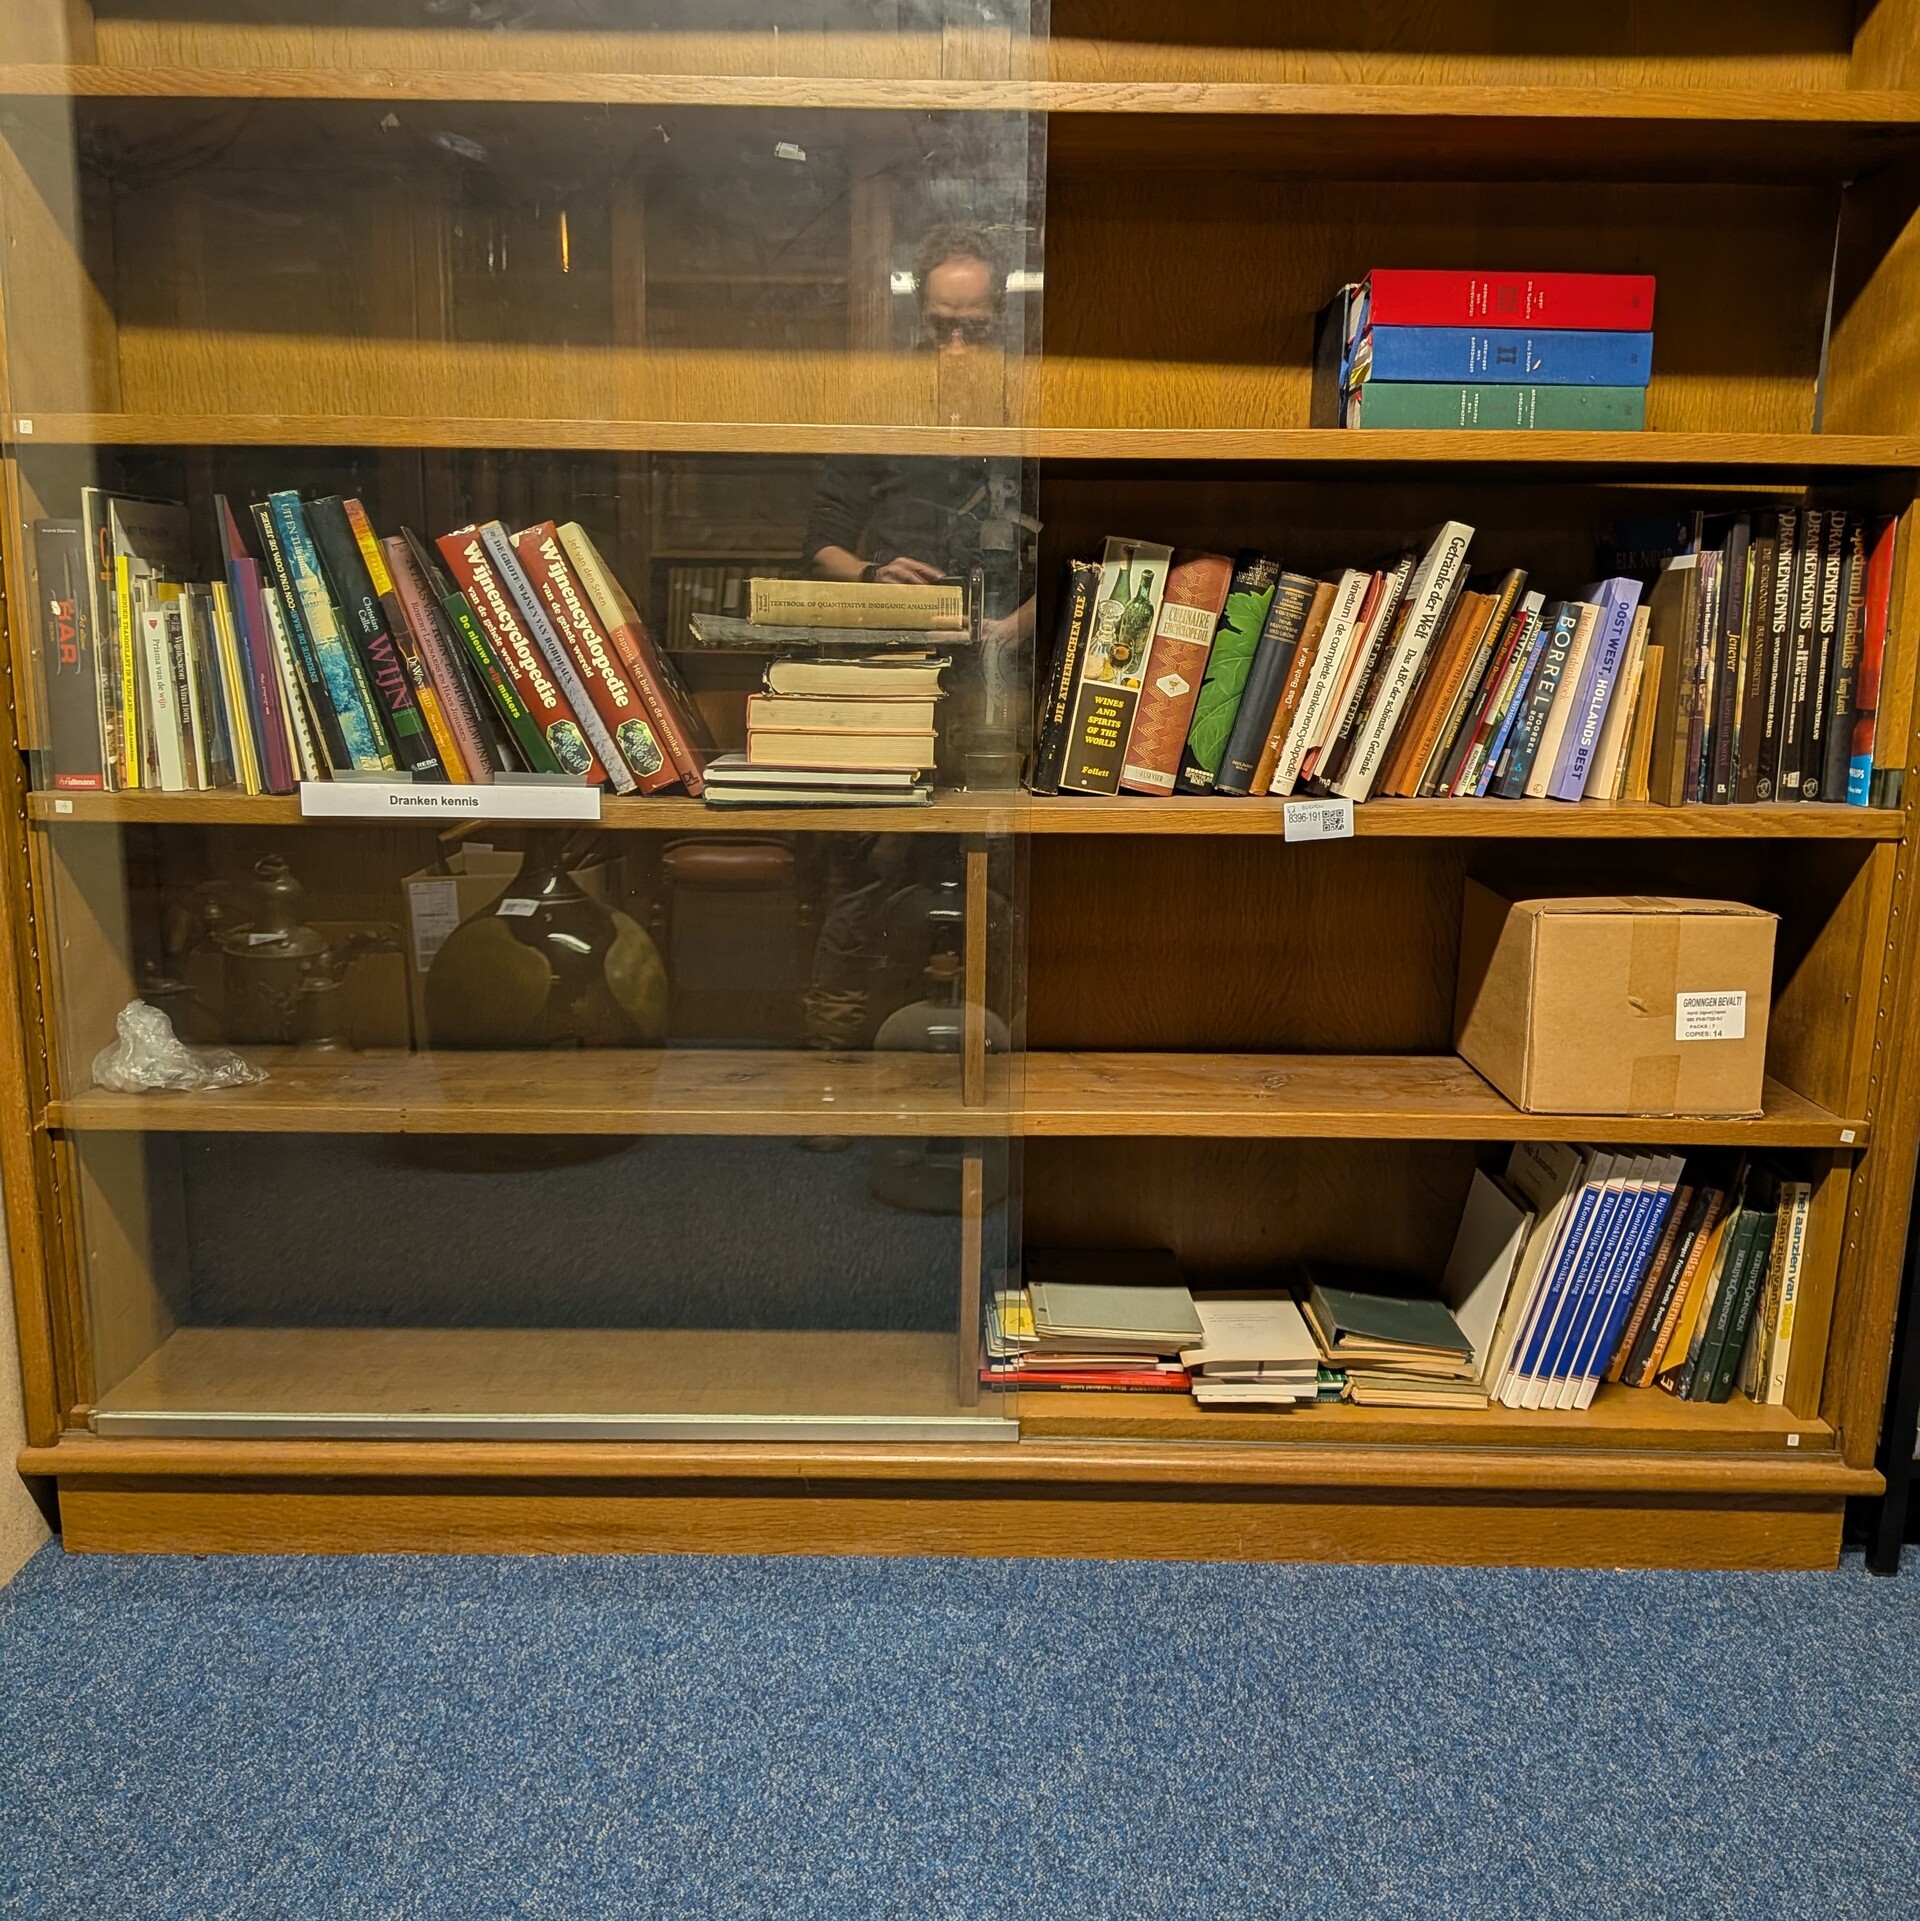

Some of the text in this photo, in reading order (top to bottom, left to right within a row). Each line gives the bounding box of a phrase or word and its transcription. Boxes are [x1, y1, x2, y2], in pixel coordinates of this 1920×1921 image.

[259, 511, 295, 609] CON UNA COPA DE JEREZ
[404, 557, 430, 602] ATLAS
[566, 536, 606, 606] Jef van den Steen
[1413, 536, 1465, 639] Getränke der Welt
[1772, 515, 1795, 632] DRANKENKENNIS
[1799, 510, 1821, 628] DRANKENKENNIS
[1820, 516, 1845, 633] DRANKENKENNIS
[357, 608, 371, 632] Callec
[362, 596, 378, 631] Christian
[423, 601, 439, 628] VAN
[465, 541, 555, 707] Wijnencyclopedie
[492, 539, 573, 684] DE GROTE WIJNEN VAN BORDEAUX
[540, 538, 627, 706] Wijnencyclopedie
[768, 599, 805, 607] TEXTBOOK
[807, 600, 816, 608] OF
[817, 600, 867, 610] QUANTITATIVE
[1168, 611, 1211, 629] CULINAIRE
[1494, 611, 1505, 622] EN
[1498, 578, 1518, 612] KLASSIEKE
[1750, 547, 1772, 697] DE GEKROONDE BRANDERSKETEL
[458, 614, 470, 629] De
[467, 630, 490, 664] nieuwe
[467, 585, 522, 680] van de gehele wereld
[542, 581, 594, 678] van de gehele wereld
[1162, 622, 1209, 642] ENCYCLOPEDIE
[1339, 560, 1411, 738] INTERNATIONALE DRANKRECEPTEN
[1484, 620, 1501, 646] TRENDY
[1508, 605, 1536, 665] JENEVER
[1559, 611, 1592, 702] Het literair drinkboek
[1726, 629, 1740, 672] Jenever
[1841, 595, 1862, 668] Drankatlas
[152, 638, 167, 709] Prisma van de wijn
[368, 633, 412, 708] WIJN
[410, 601, 427, 631] ROBERT
[422, 632, 442, 672] LEENAERS
[437, 672, 445, 683] EN
[441, 684, 454, 706] HANS
[450, 707, 467, 741] JORISSEN
[443, 661, 458, 682] EN
[1284, 580, 1361, 776] vinetum de complete drankenencyclopedie
[1461, 645, 1491, 698] COCKTAILS
[1533, 615, 1575, 704] BORREL
[1794, 649, 1808, 701] HOTELSCHOOL
[615, 628, 681, 756] Trappist. Het bier en de monniken
[1094, 695, 1125, 709] WINES
[1095, 707, 1117, 717] AND
[1358, 647, 1417, 775] Das ABC der schönsten Getränke
[1414, 735, 1433, 767] WALTER,
[1429, 695, 1449, 732] MODERNE
[1446, 625, 1481, 694] DESTILLIERKUNST
[1453, 714, 1462, 722] DE
[1456, 698, 1469, 716] VOOR
[1523, 709, 1536, 731] BOEK
[1571, 601, 1629, 780] OOST WEST, HOLLANDS BEST
[449, 681, 494, 774] MOEZELWIJNEN
[1085, 735, 1116, 748] WORLD
[1087, 715, 1121, 729] SPIRITS
[1087, 726, 1118, 738] OF THE
[1442, 721, 1460, 749] LIEFHEBBER
[1525, 712, 1544, 753] WOORDEN
[416, 757, 437, 768] REBO
[1081, 765, 1110, 778] Follett
[389, 795, 480, 807] Dranken kennis
[1288, 811, 1321, 824] 8396-191
[1683, 996, 1742, 1008] GRONINGEN BEVALT!
[1782, 1192, 1793, 1215] het
[1551, 1194, 1595, 1292] Bij Koninklijke Beschikking
[1570, 1196, 1615, 1295] Bij Koninklijke Beschikking
[1587, 1196, 1631, 1295] Bij Koninklijke Beschikking
[1605, 1196, 1650, 1294] Bij Koninklijke Beschikking
[1622, 1196, 1667, 1295] Bij Koninklijke Beschikking
[1773, 1215, 1791, 1274] aanzien
[1622, 1199, 1687, 1349] Nederlandse ondernemers
[1652, 1204, 1719, 1356] Nederlandse ondernemers
[1770, 1274, 1782, 1301] van
